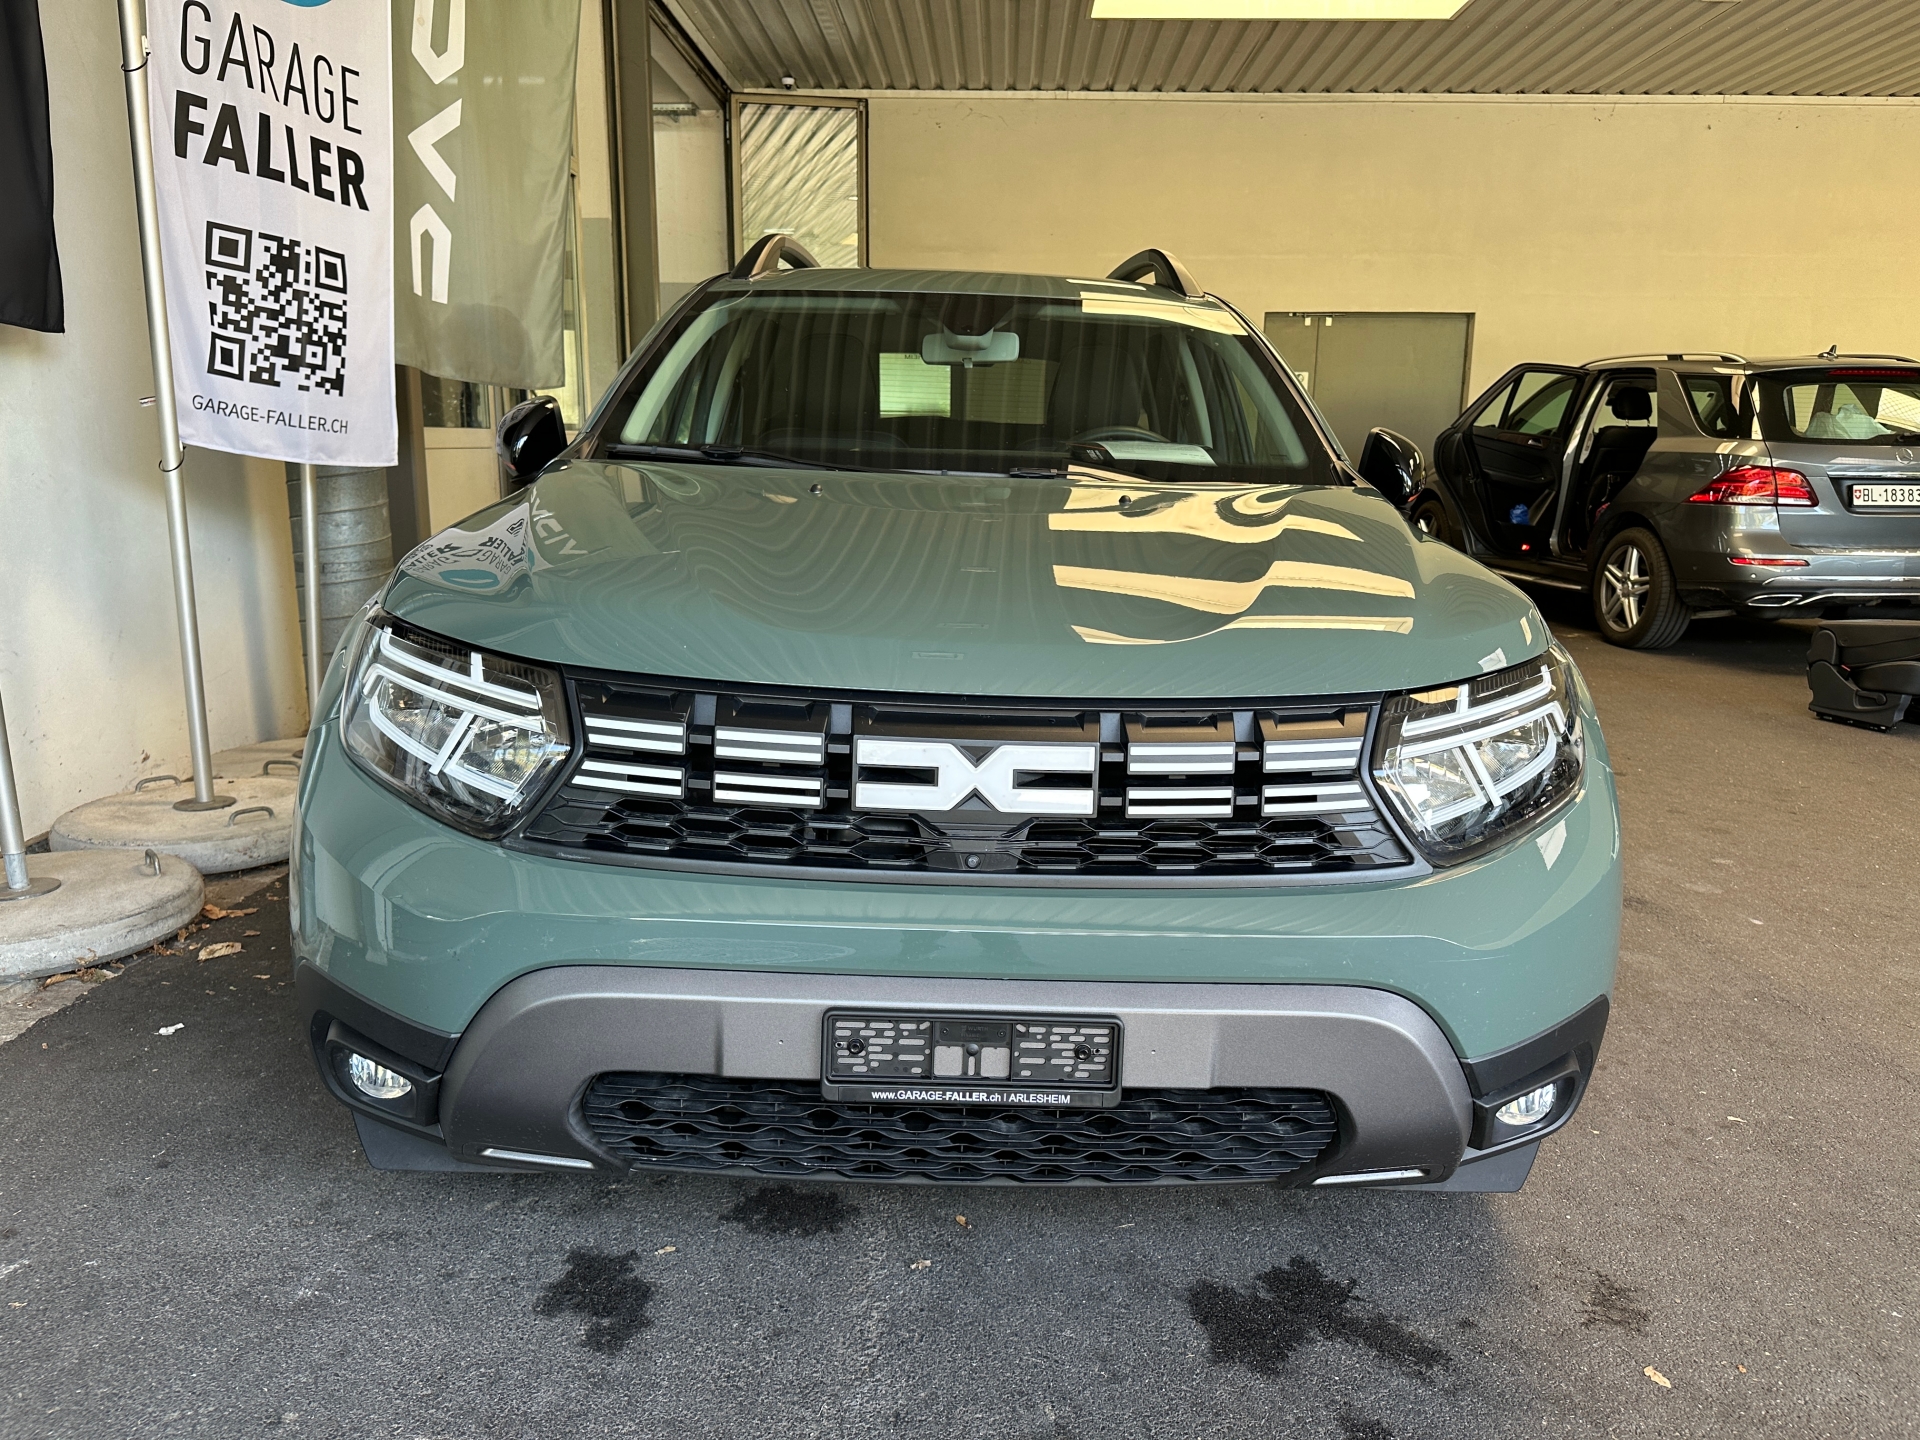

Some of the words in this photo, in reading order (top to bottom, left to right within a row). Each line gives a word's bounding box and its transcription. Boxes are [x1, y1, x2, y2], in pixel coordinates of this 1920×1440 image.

[179, 0, 362, 135] GARAGE
[174, 89, 370, 212] FALLER
[192, 394, 349, 435] GARAGE-FALLER.CH
[871, 1090, 1001, 1103] www.GARAGE-FALLER.ch
[1009, 1093, 1071, 1104] ARLESHEIM
